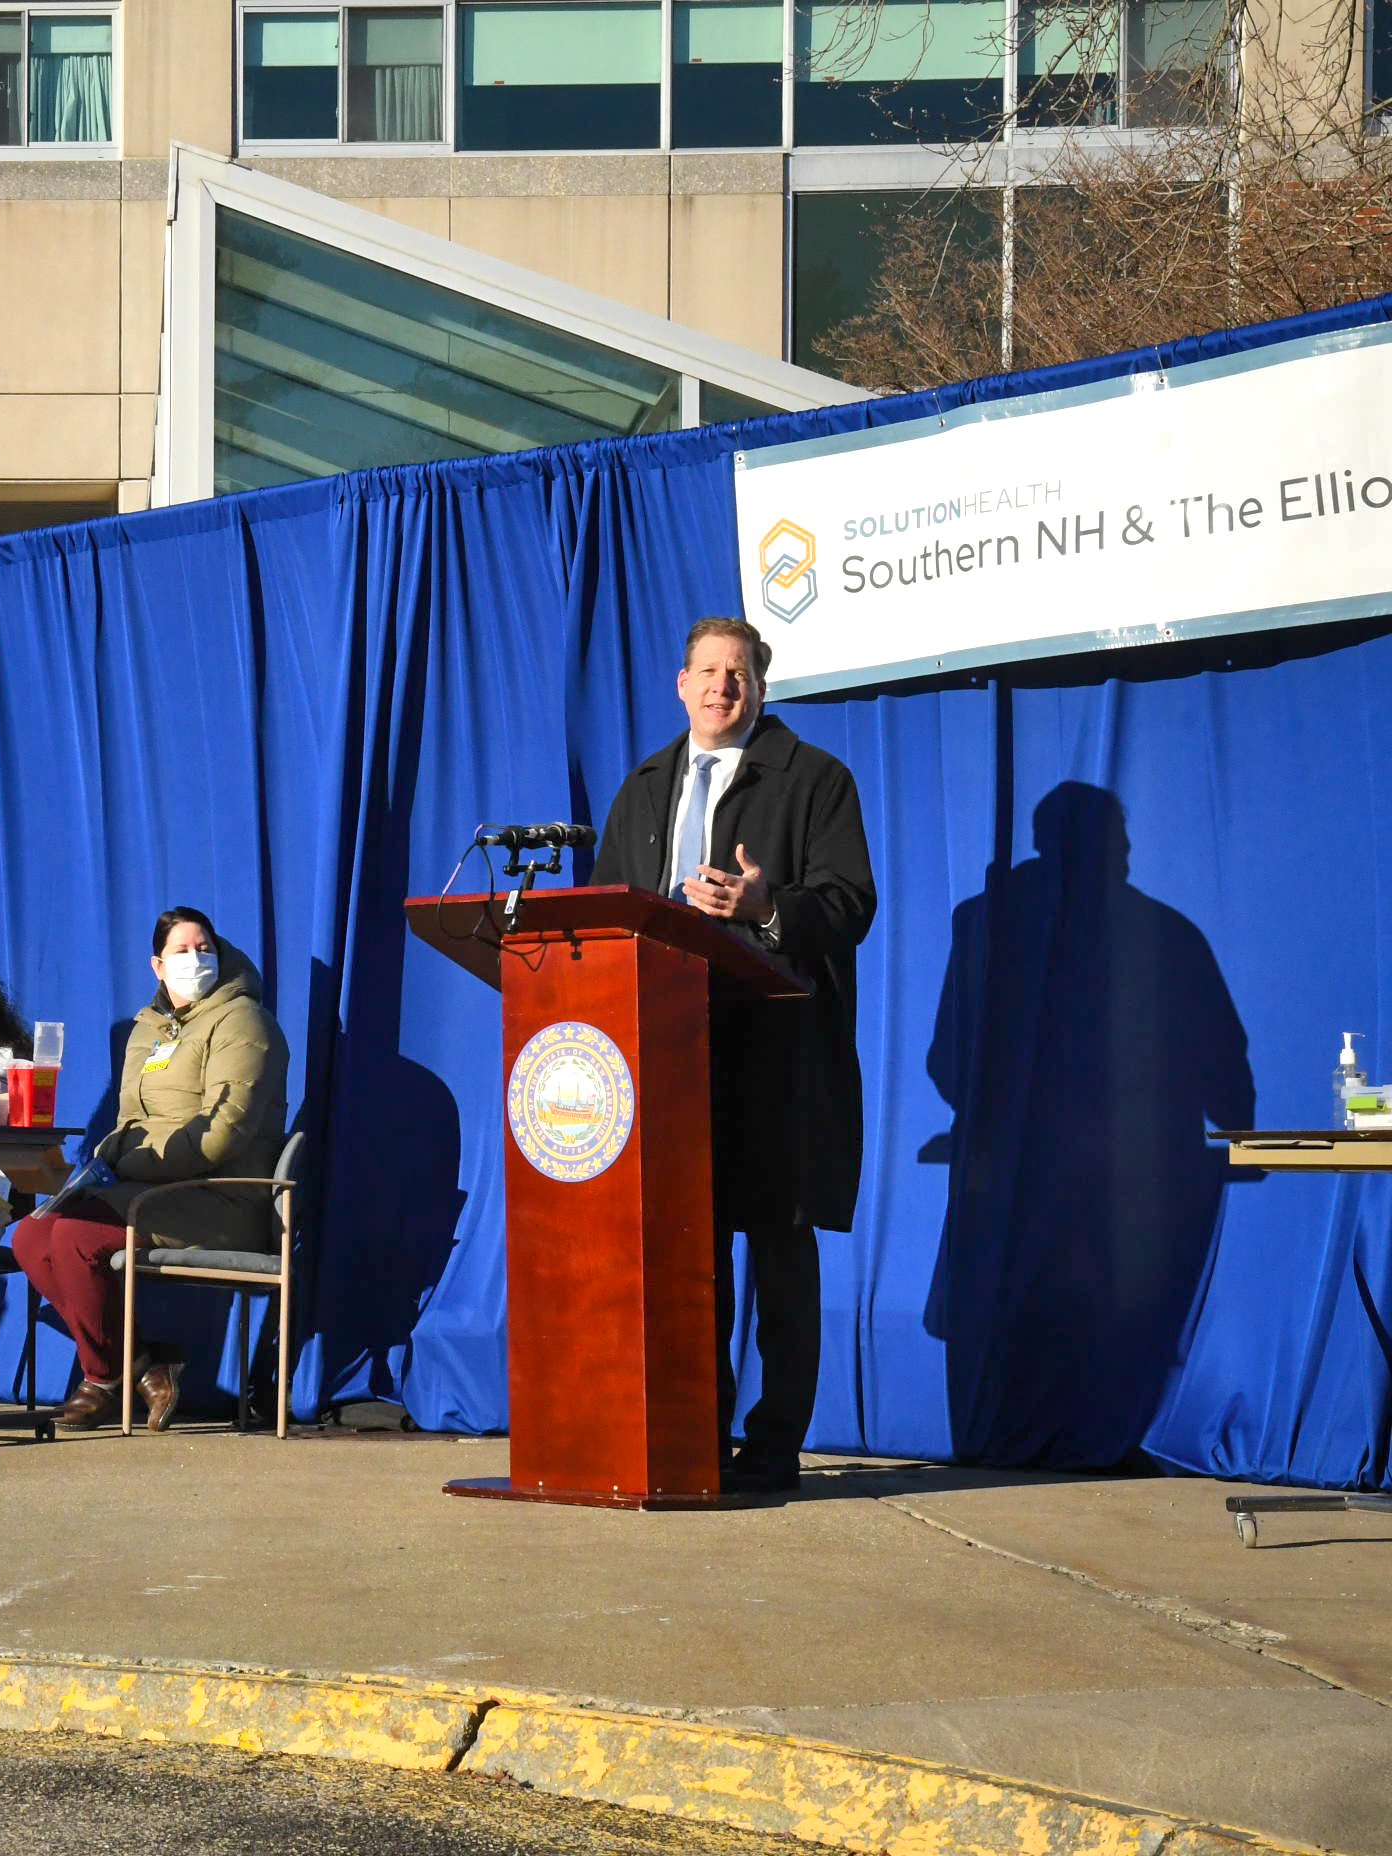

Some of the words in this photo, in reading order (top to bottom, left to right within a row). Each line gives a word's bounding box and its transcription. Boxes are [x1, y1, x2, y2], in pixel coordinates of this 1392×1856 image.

[841, 530, 1020, 594] Southern
[1035, 509, 1105, 561] NH
[1120, 502, 1156, 546] &
[1169, 490, 1264, 538] The
[1280, 469, 1392, 522] Ellio
[843, 479, 1062, 540] SOLUTIONHEALTH
